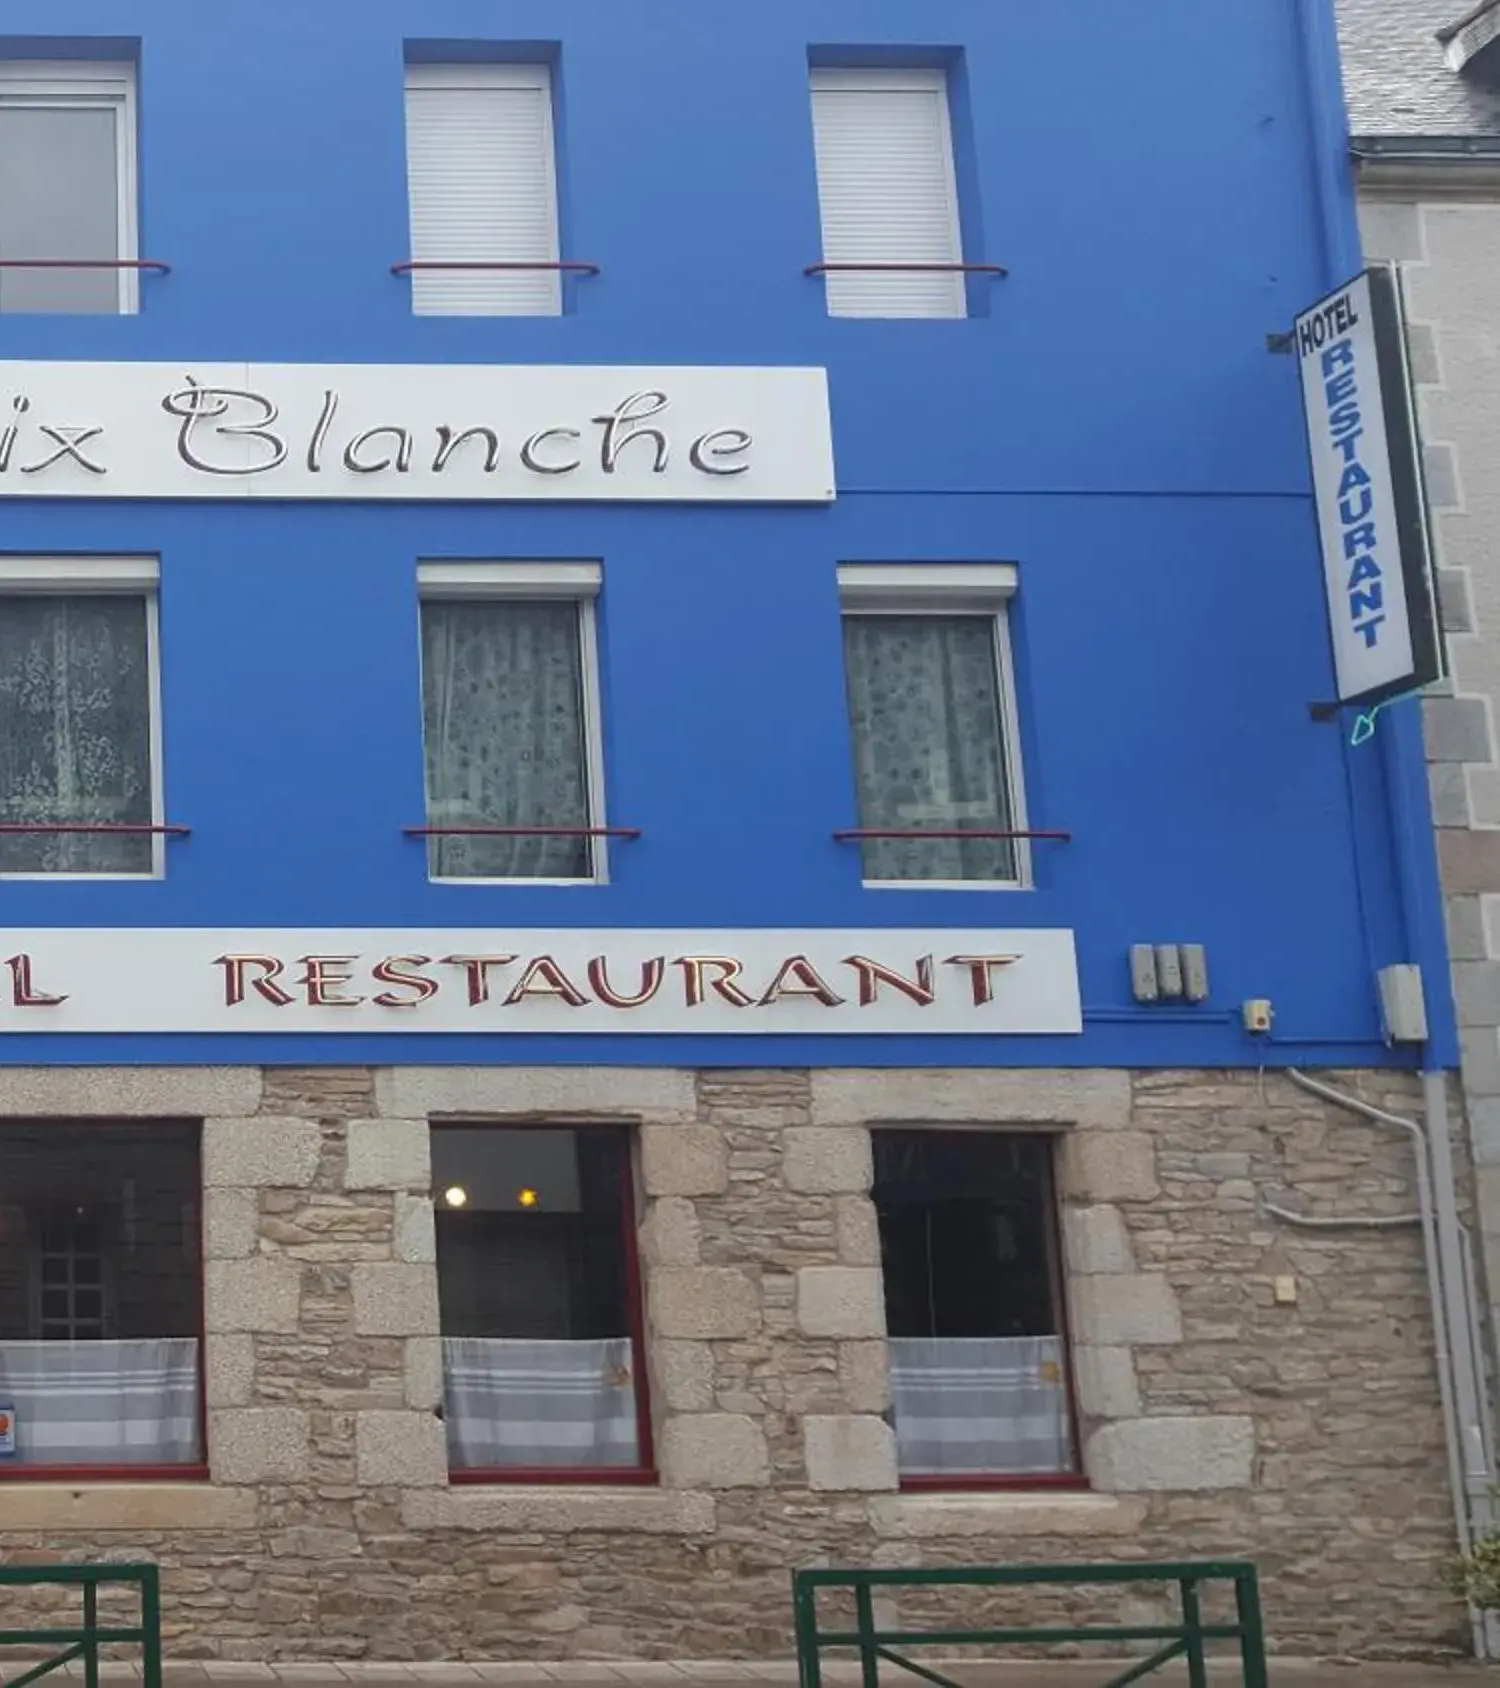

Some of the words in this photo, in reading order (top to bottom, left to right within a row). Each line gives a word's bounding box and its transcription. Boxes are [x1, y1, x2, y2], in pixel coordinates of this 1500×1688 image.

[1299, 293, 1358, 358] HOTEL
[161, 375, 753, 476] Blanche
[1321, 337, 1385, 649] RESTAURANT
[211, 954, 1024, 1010] RESTAURANT
